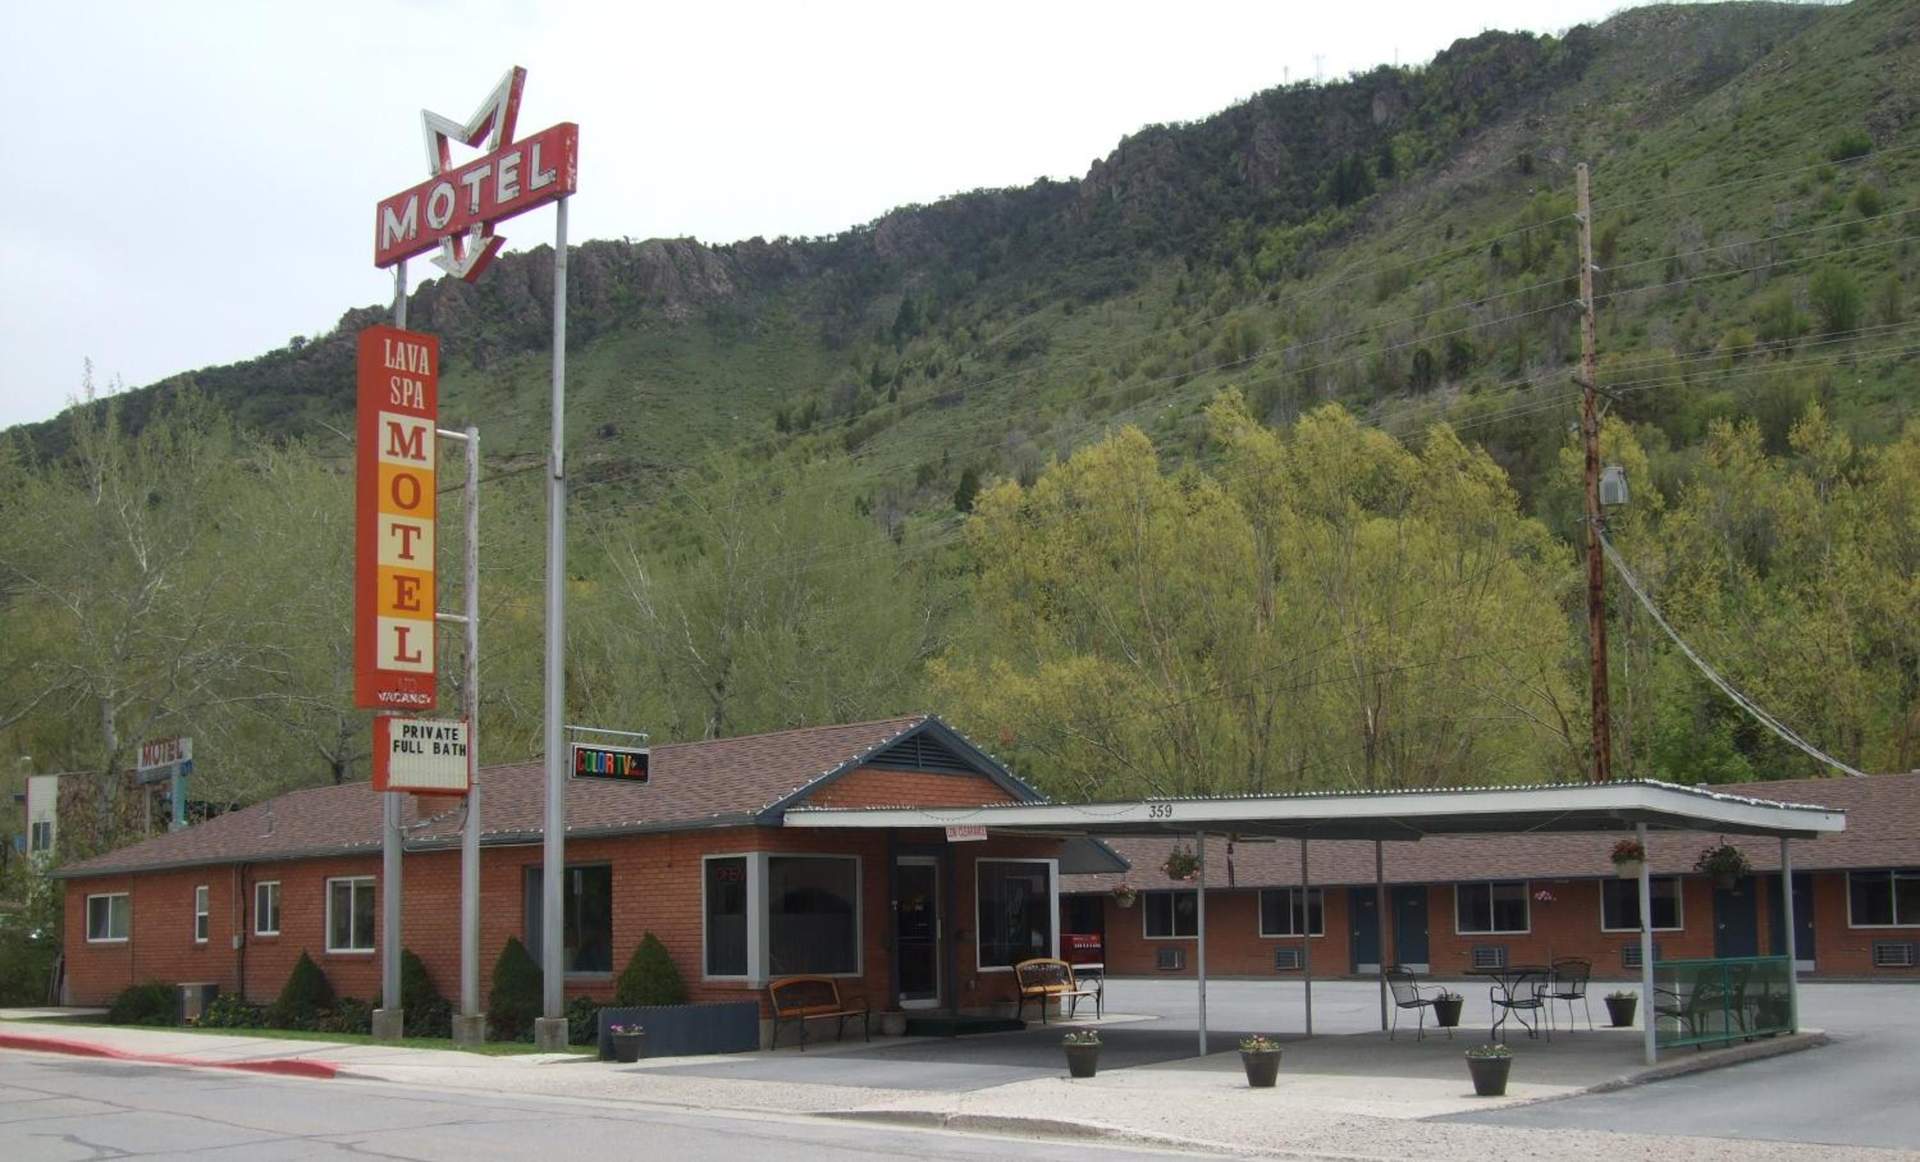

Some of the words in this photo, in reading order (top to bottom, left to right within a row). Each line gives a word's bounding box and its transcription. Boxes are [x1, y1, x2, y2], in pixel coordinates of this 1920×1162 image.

[380, 143, 556, 251] MOTEL
[384, 338, 431, 376] LAVA
[390, 376, 425, 410] SPA
[386, 420, 427, 664] MOTEL
[378, 691, 432, 704] VACANCY
[402, 724, 459, 740] PRIVATE
[143, 739, 183, 767] MOTEL
[393, 740, 424, 754] FULL
[433, 742, 467, 757] BATH
[577, 749, 615, 774] COLOR
[616, 754, 632, 775] TV
[1149, 804, 1172, 818] 359
